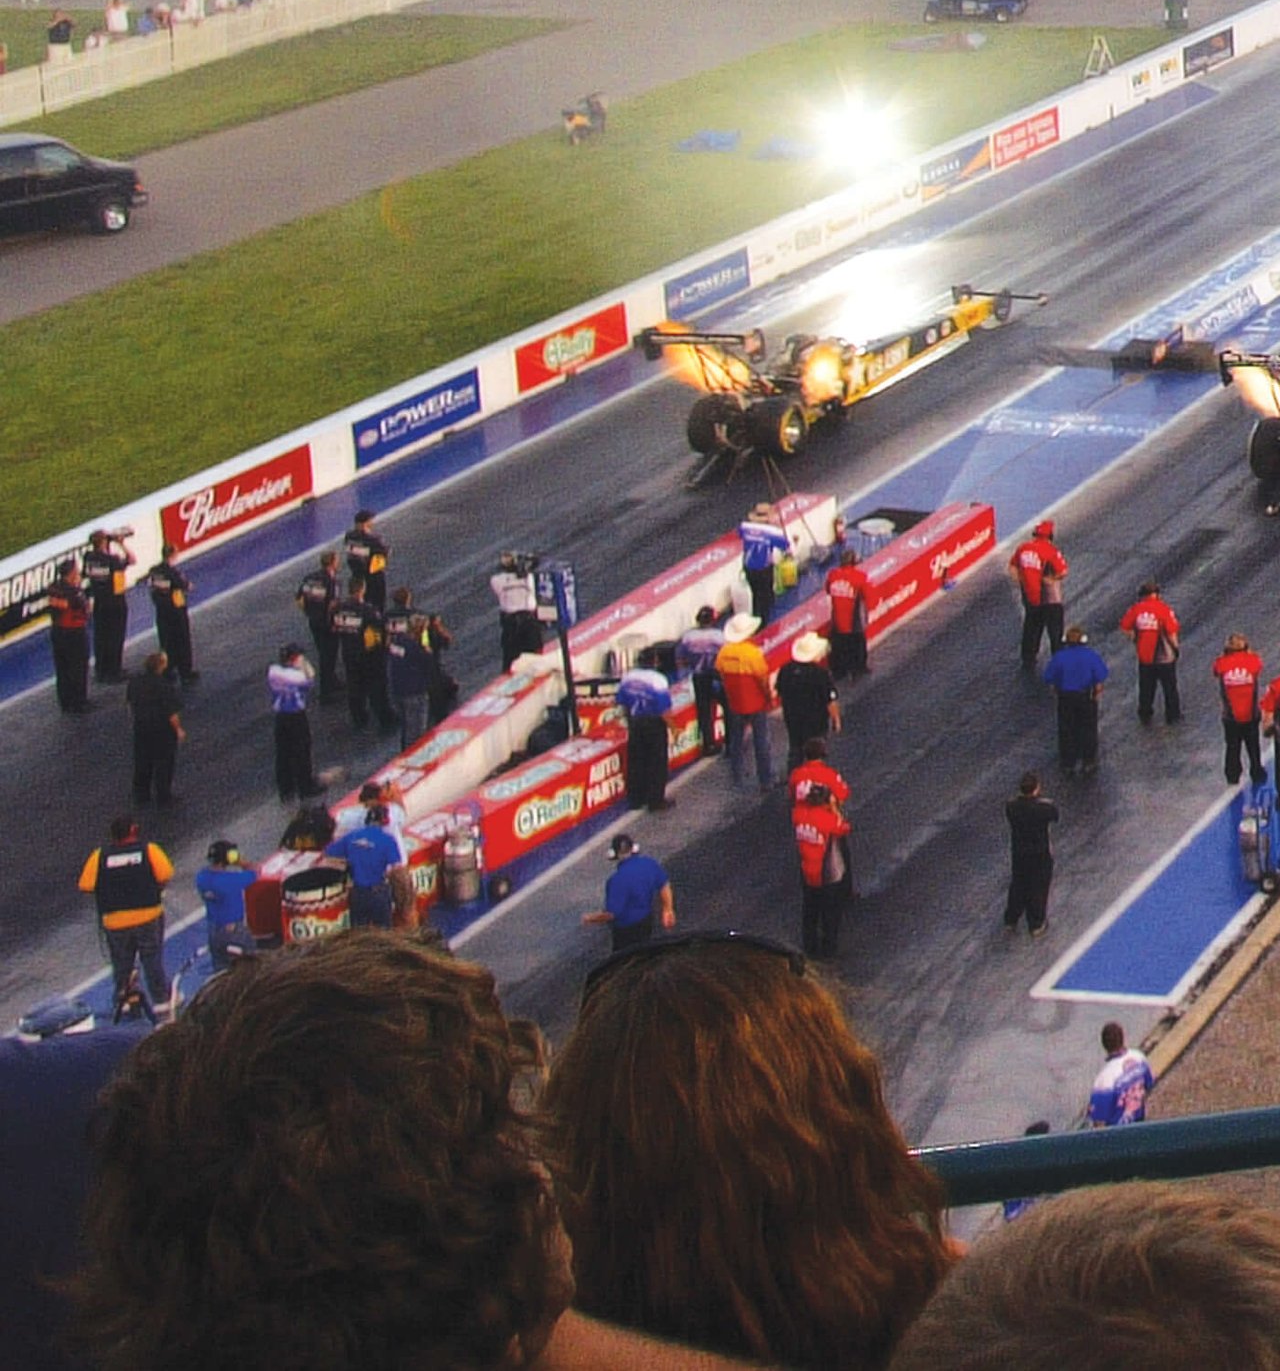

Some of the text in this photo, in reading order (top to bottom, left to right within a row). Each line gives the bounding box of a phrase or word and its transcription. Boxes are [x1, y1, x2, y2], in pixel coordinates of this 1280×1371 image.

[179, 474, 293, 543] Budweiser
[930, 526, 992, 579] Budweiser
[586, 776, 625, 810] PARTS
[589, 752, 621, 784] AUTO
[515, 787, 582, 837] O'Reilly
